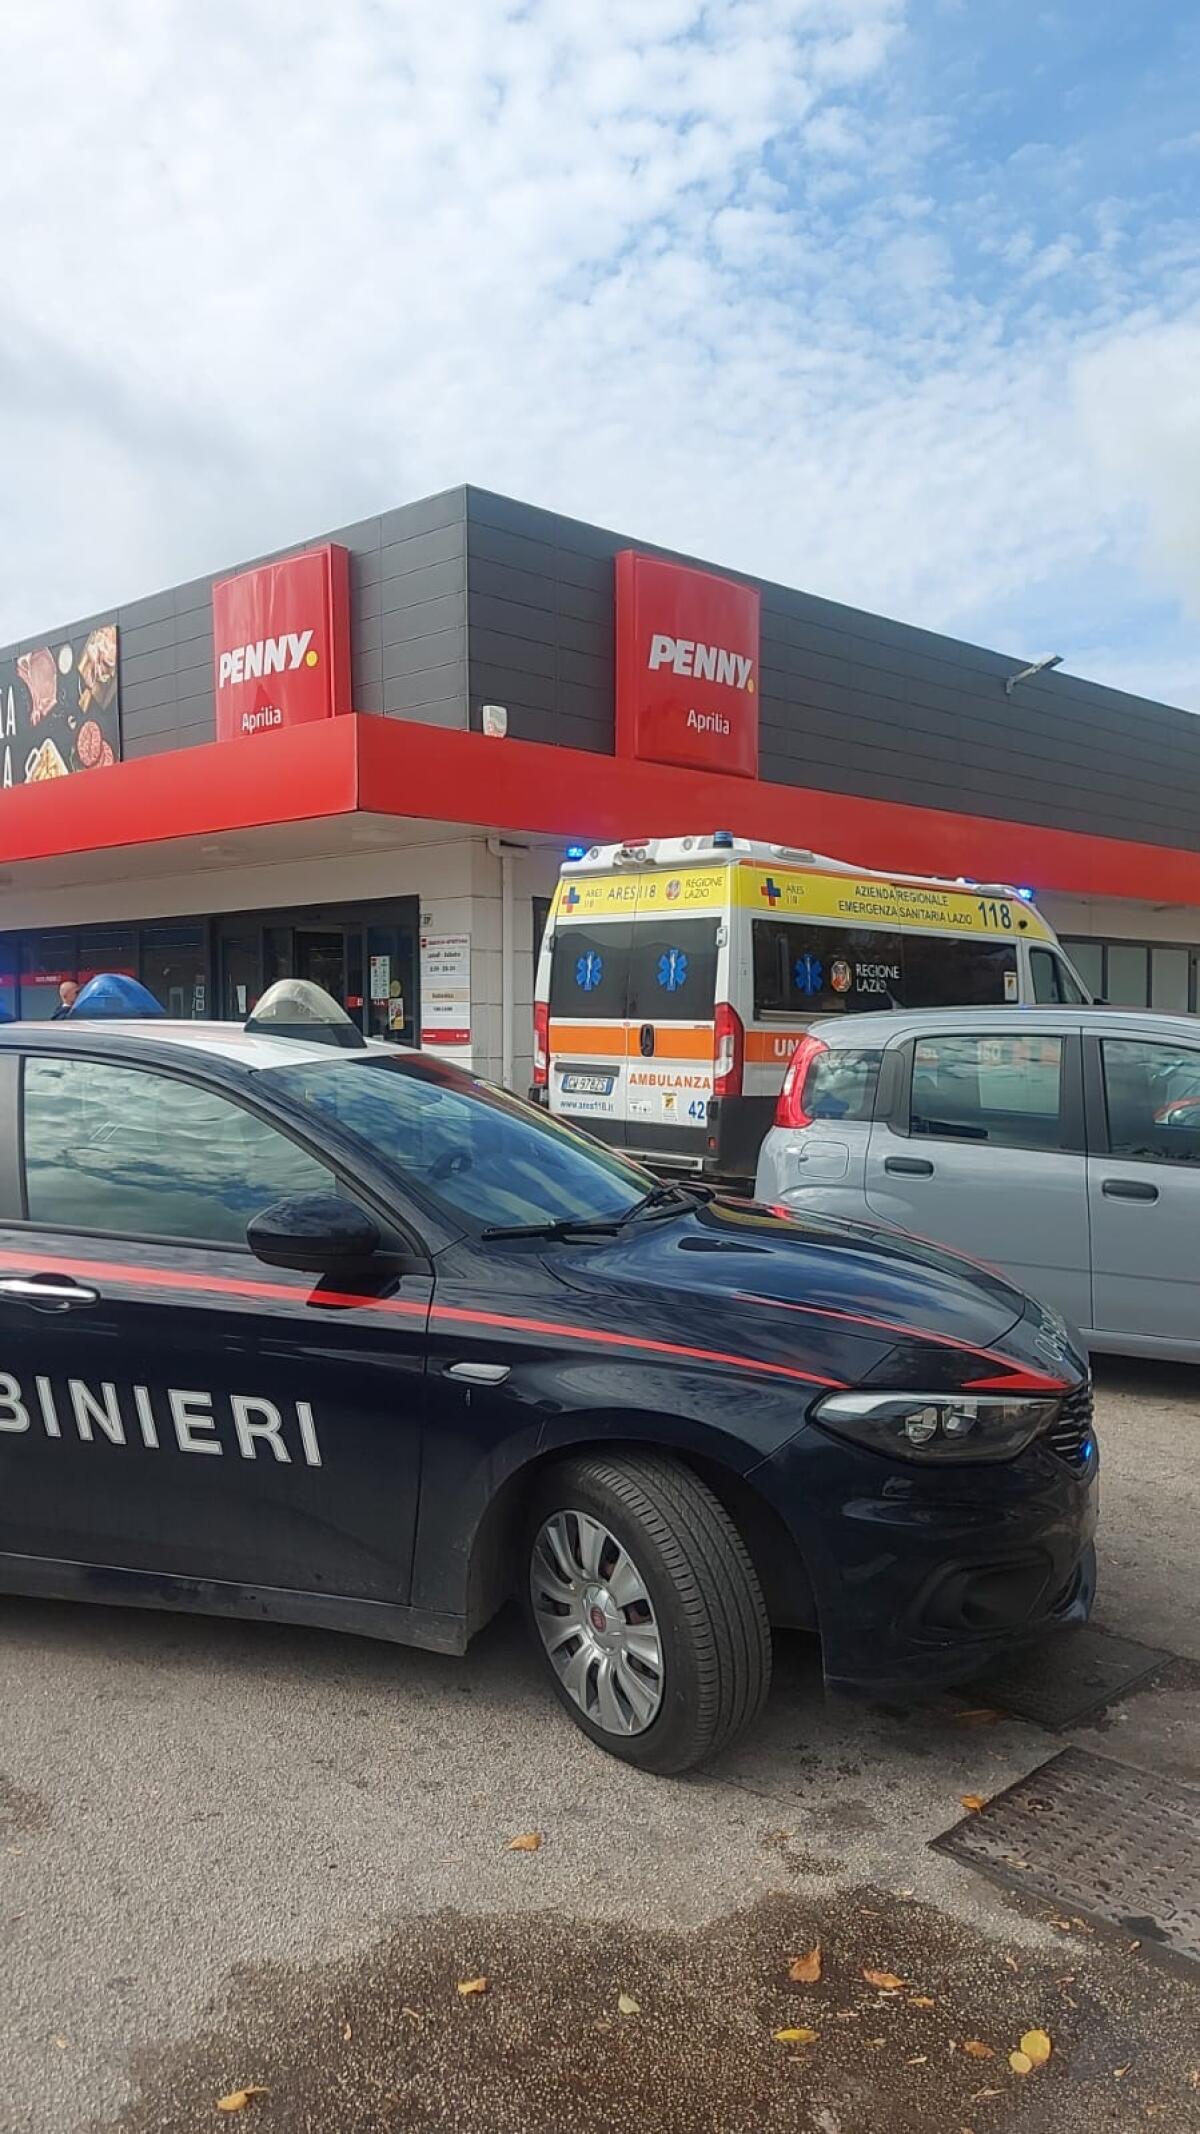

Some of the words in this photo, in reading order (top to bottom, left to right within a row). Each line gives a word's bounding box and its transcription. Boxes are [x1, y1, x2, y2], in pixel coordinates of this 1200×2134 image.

[0, 685, 16, 738] A
[242, 705, 282, 734] Aprilia
[687, 709, 730, 735] Aprilia
[686, 876, 724, 888] REGIONE
[685, 888, 709, 899] LAZIO
[855, 885, 896, 901] AZIENDA
[896, 888, 950, 906] REGIONALE
[839, 901, 897, 916] EMERGENZA
[899, 907, 946, 922] SANITARIA
[947, 912, 973, 925] LAZIO
[978, 901, 1012, 929] 118
[856, 963, 901, 979] REGIONE
[856, 978, 887, 993] LAZIO
[629, 1073, 711, 1090] AMBULANZA
[688, 1100, 706, 1119] 42
[0, 1371, 323, 1467] BINIERI
